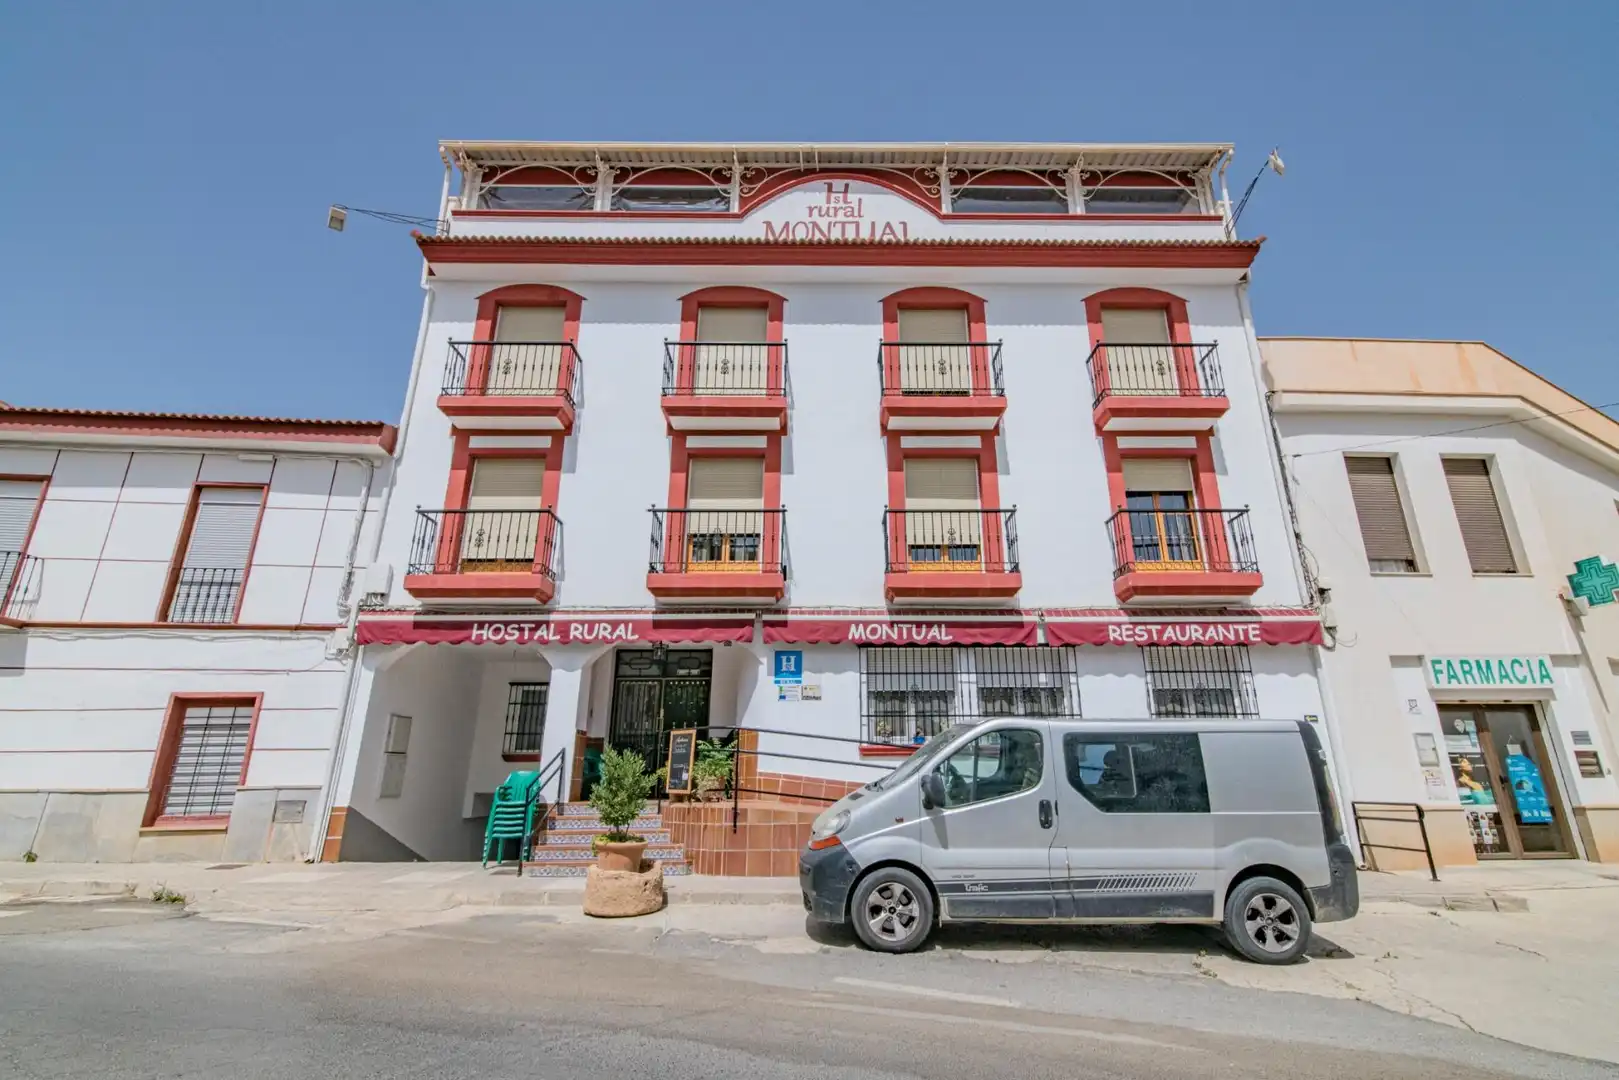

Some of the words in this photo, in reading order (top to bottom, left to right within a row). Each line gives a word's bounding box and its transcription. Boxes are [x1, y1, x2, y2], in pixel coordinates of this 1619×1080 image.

[806, 198, 864, 218] rural
[471, 623, 560, 641] HOSTAL
[569, 622, 639, 640] RURAL
[848, 623, 953, 640] MONTUAL
[1108, 624, 1262, 642] RESTAURANTE
[1430, 658, 1555, 685] FARMACIA
